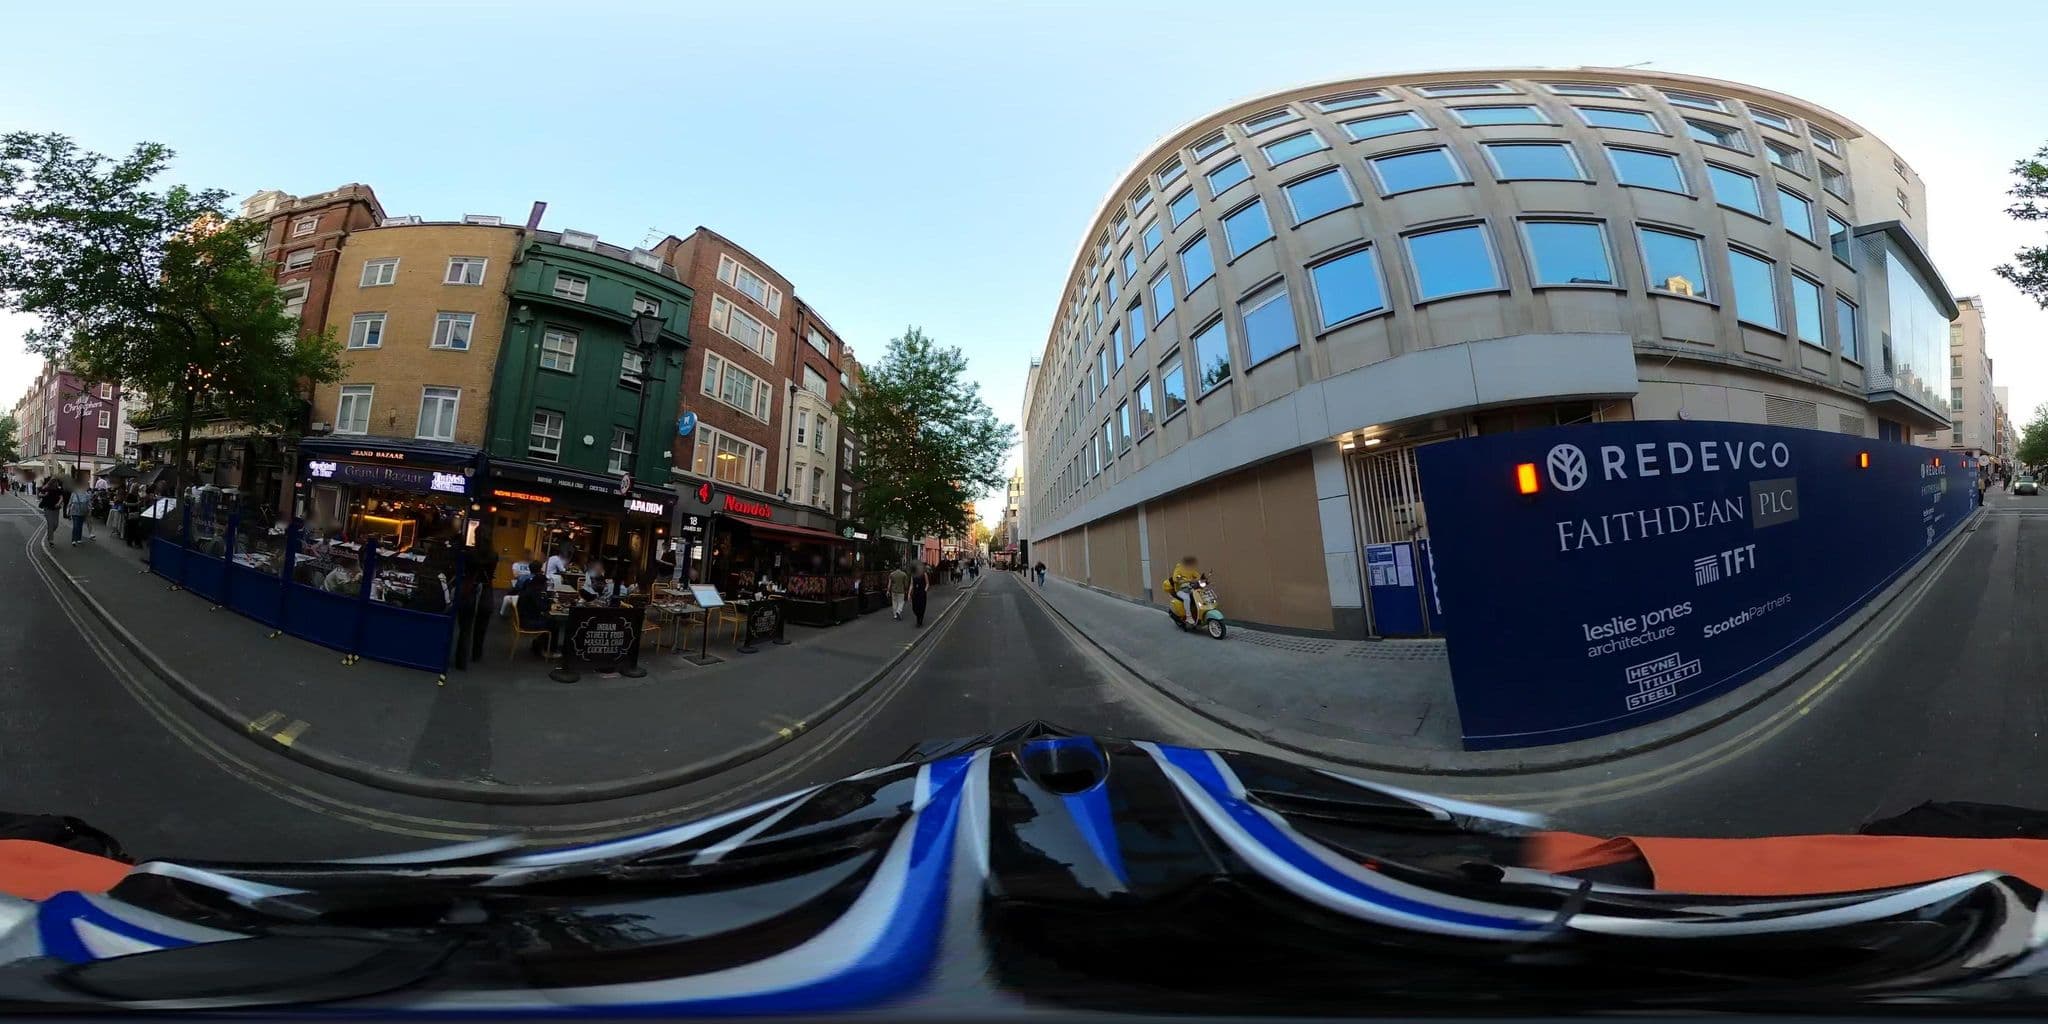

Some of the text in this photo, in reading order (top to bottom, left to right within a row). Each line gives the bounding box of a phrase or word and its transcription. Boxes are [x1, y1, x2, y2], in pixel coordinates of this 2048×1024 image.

[344, 465, 424, 483] Grand Bazaar
[1600, 441, 1790, 481] REDEVCO
[724, 495, 771, 518] Nando's
[689, 516, 698, 526] 18
[1556, 489, 1793, 552] FAITHDEAN PLC
[1721, 543, 1756, 577] TFT
[1583, 601, 1693, 642] leslie jones
[1587, 624, 1676, 658] architecture
[1630, 657, 1678, 680] HEYNE
[1644, 664, 1698, 691] TILLETT
[1630, 688, 1673, 707] STEEL
